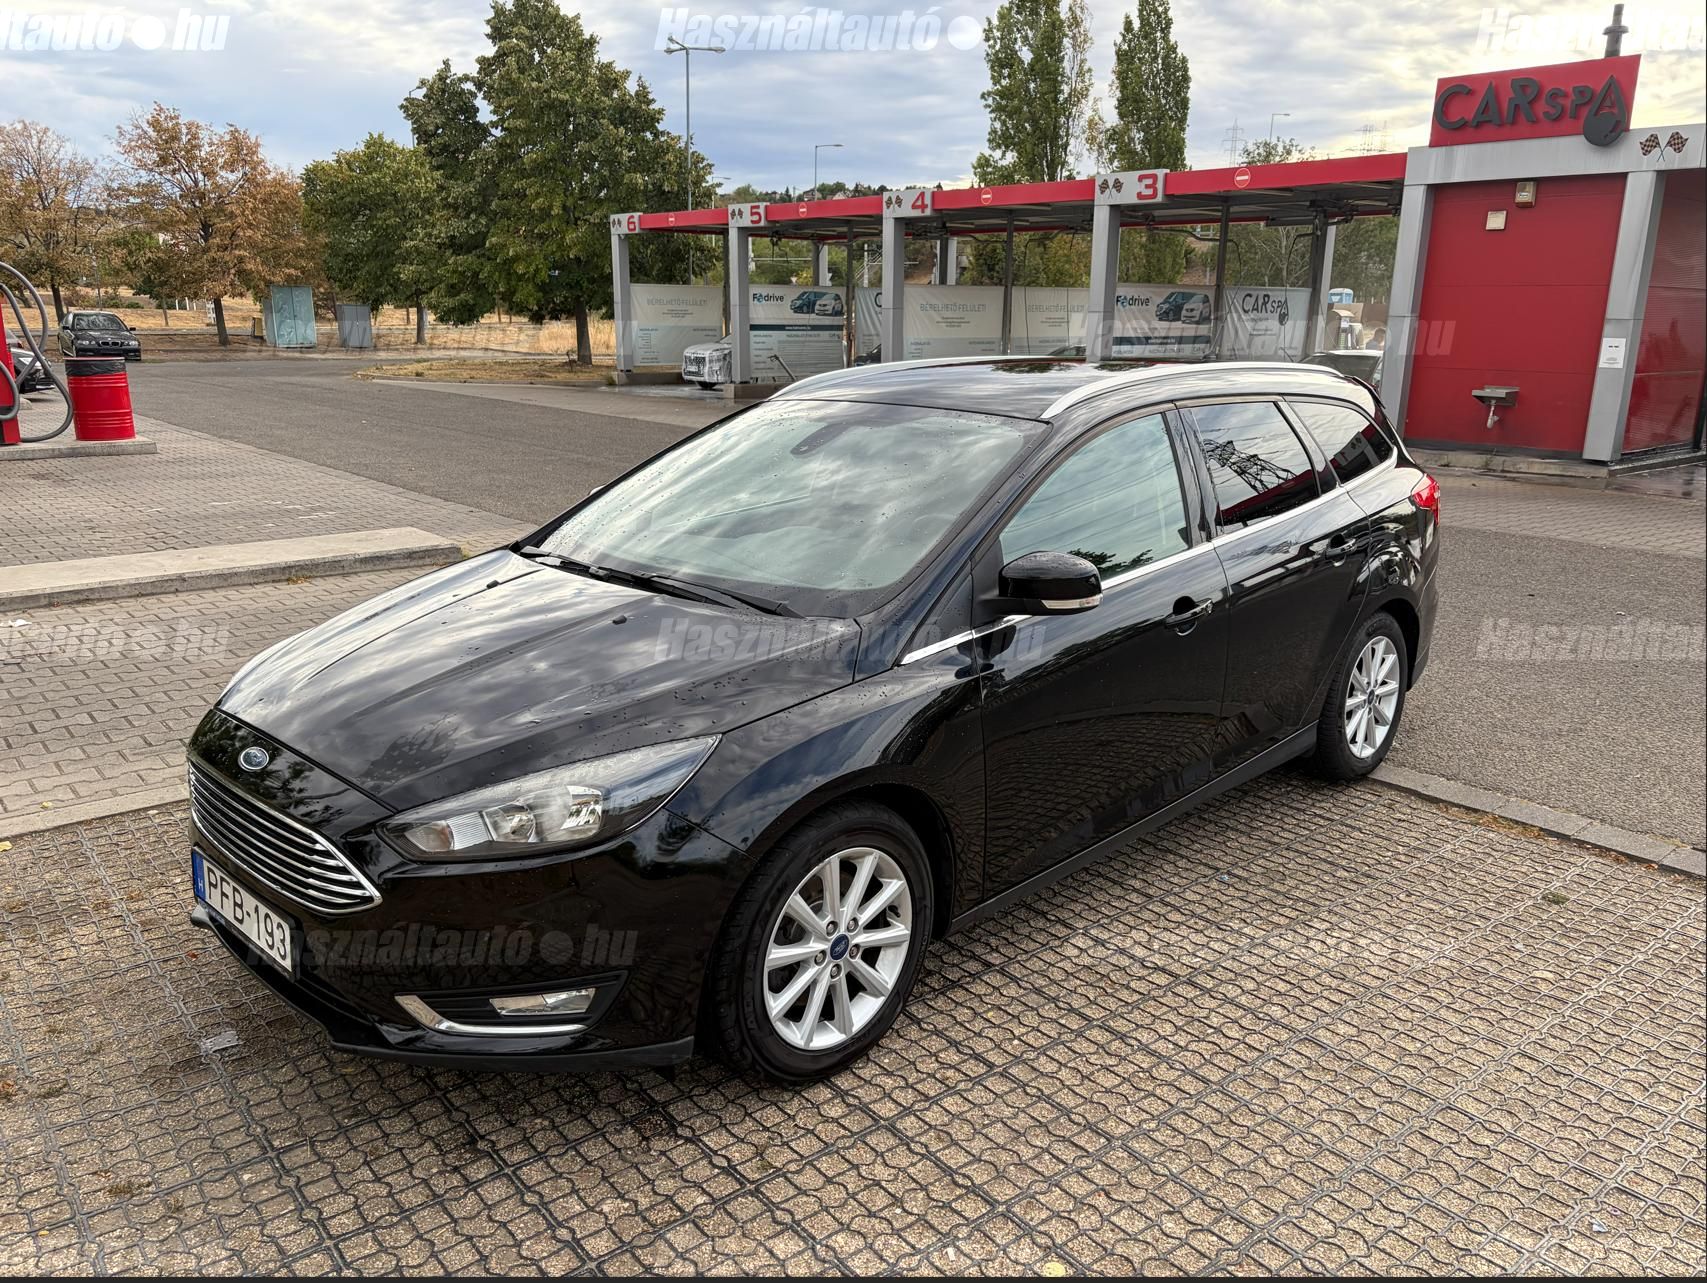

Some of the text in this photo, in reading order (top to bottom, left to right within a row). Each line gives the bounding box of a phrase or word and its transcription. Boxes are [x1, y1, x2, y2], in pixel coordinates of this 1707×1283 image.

[1137, 172, 1158, 201] 3
[911, 191, 928, 214] 4
[626, 214, 637, 232] 6
[750, 205, 762, 225] 5
[207, 865, 287, 961] PFB-193
